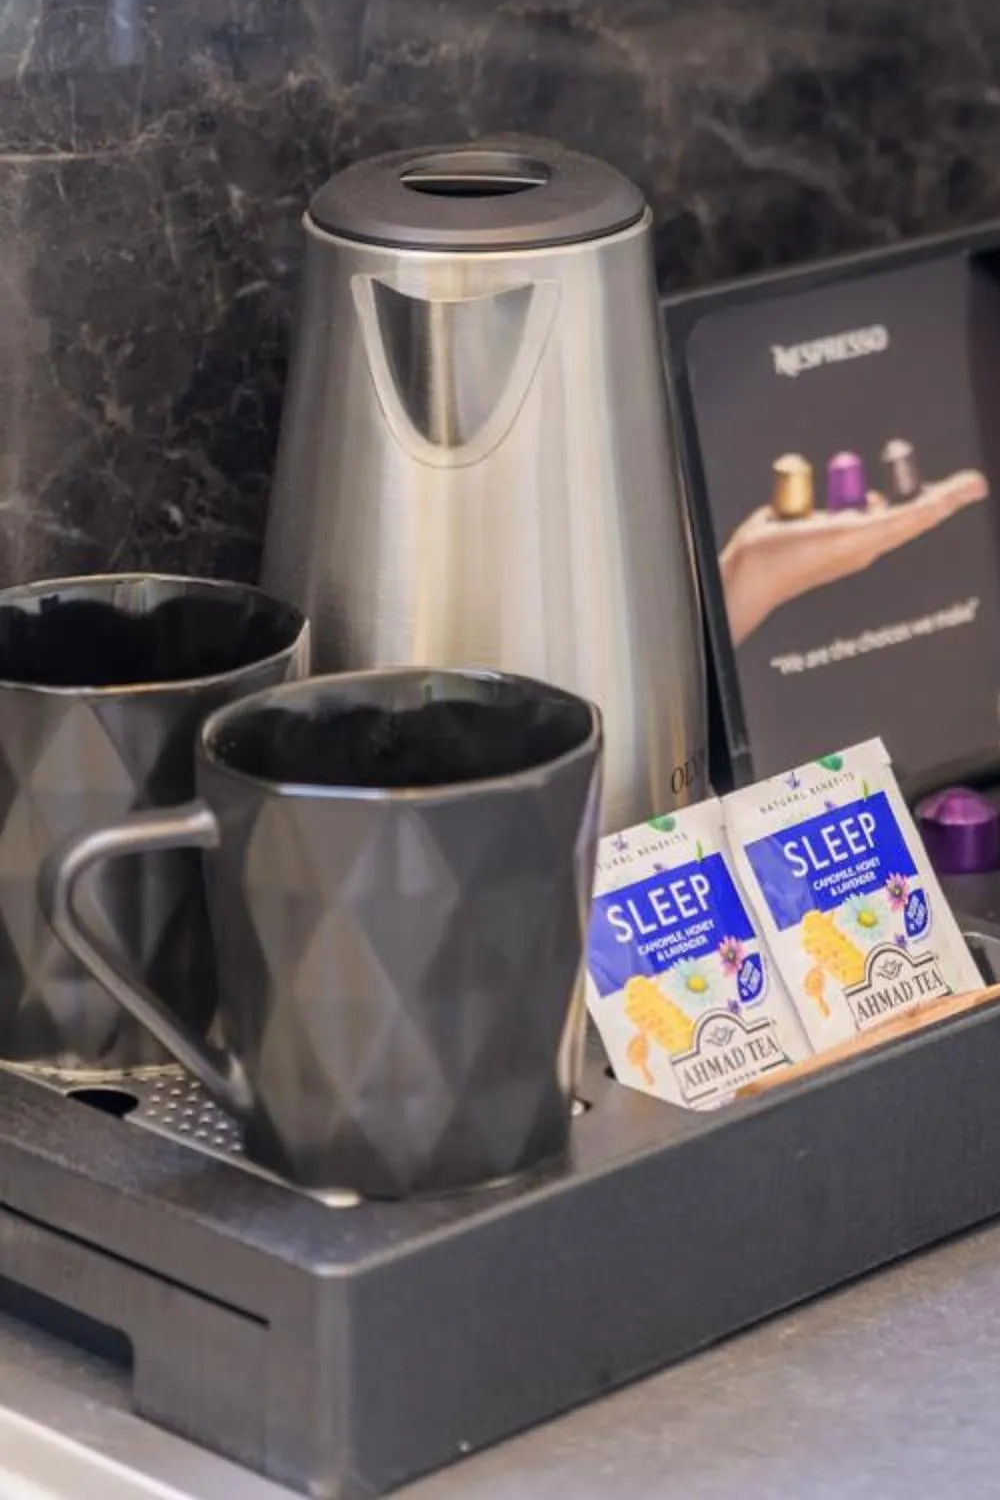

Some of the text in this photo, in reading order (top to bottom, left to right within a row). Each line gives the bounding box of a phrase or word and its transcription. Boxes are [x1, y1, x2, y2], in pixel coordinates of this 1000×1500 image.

[771, 325, 889, 377] NESPRESSO
[783, 811, 877, 878] SLEEP
[607, 873, 711, 943] SLEEP
[856, 968, 944, 1022] AHMAD TEA
[683, 1048, 747, 1090] AHMAD
[744, 1033, 780, 1062] TEA
